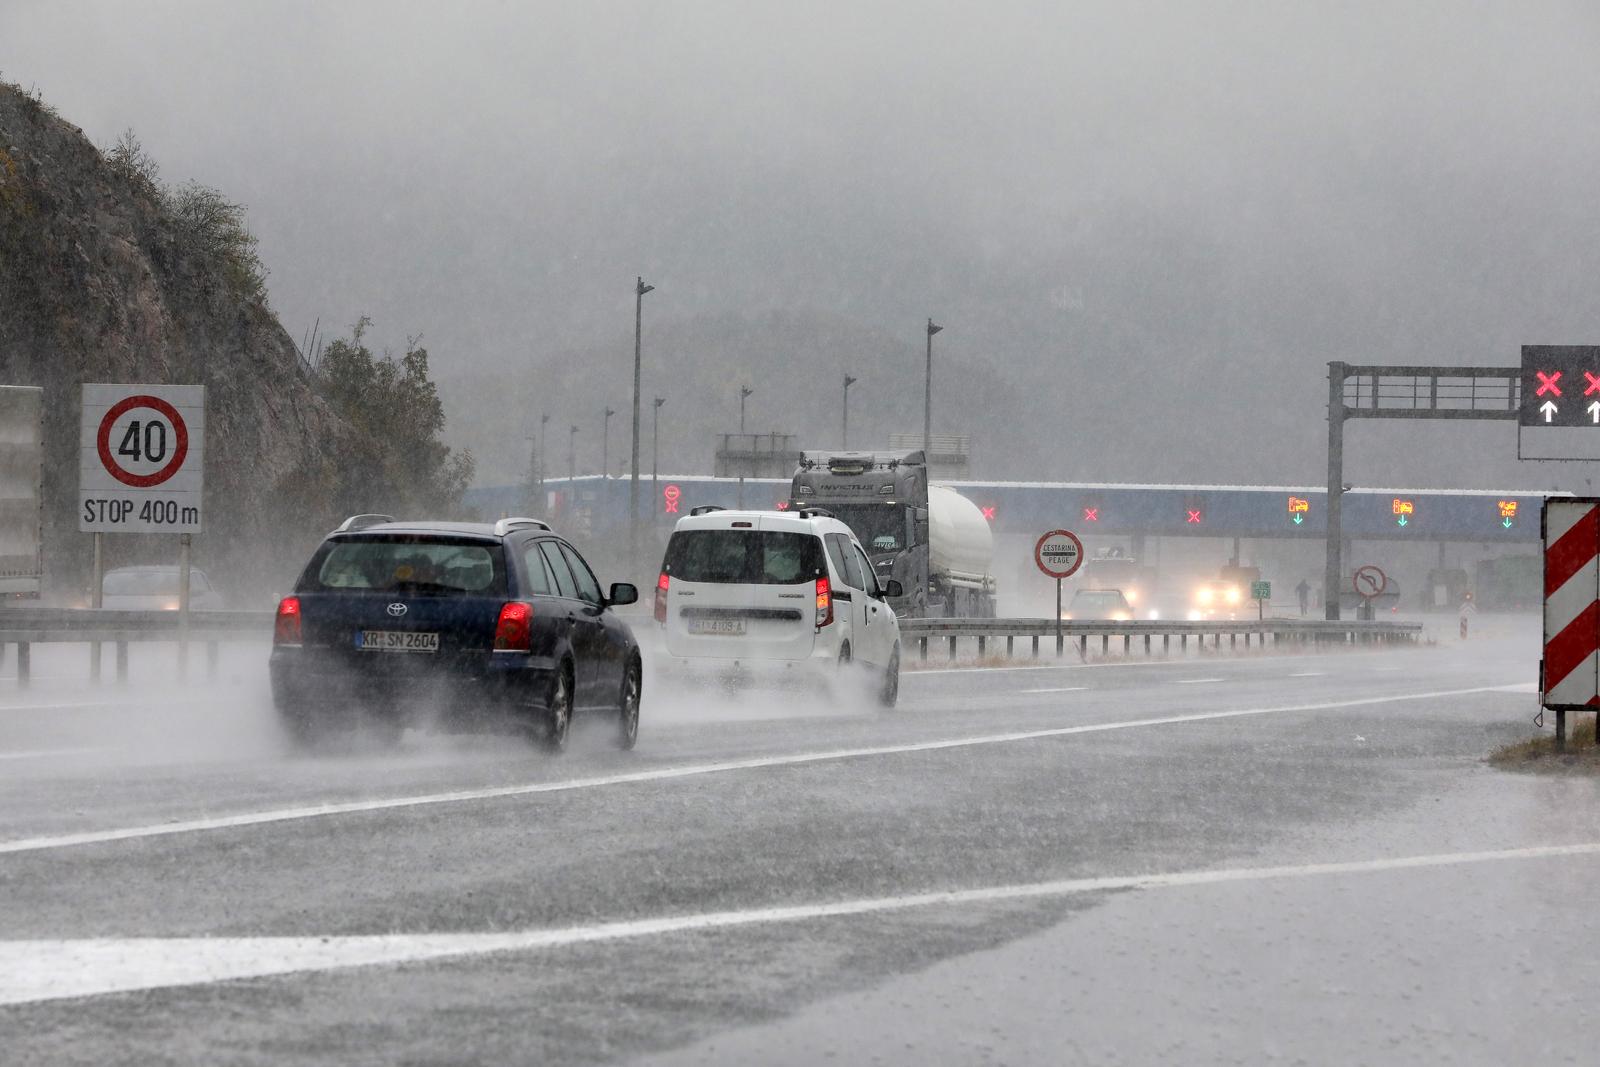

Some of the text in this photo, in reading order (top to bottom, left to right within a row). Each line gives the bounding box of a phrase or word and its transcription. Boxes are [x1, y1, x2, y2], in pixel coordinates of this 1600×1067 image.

[118, 420, 166, 463] 40
[84, 499, 198, 524] STOP 400 m
[1043, 544, 1076, 552] CESTARINA
[362, 631, 437, 648] KR SN 2604
